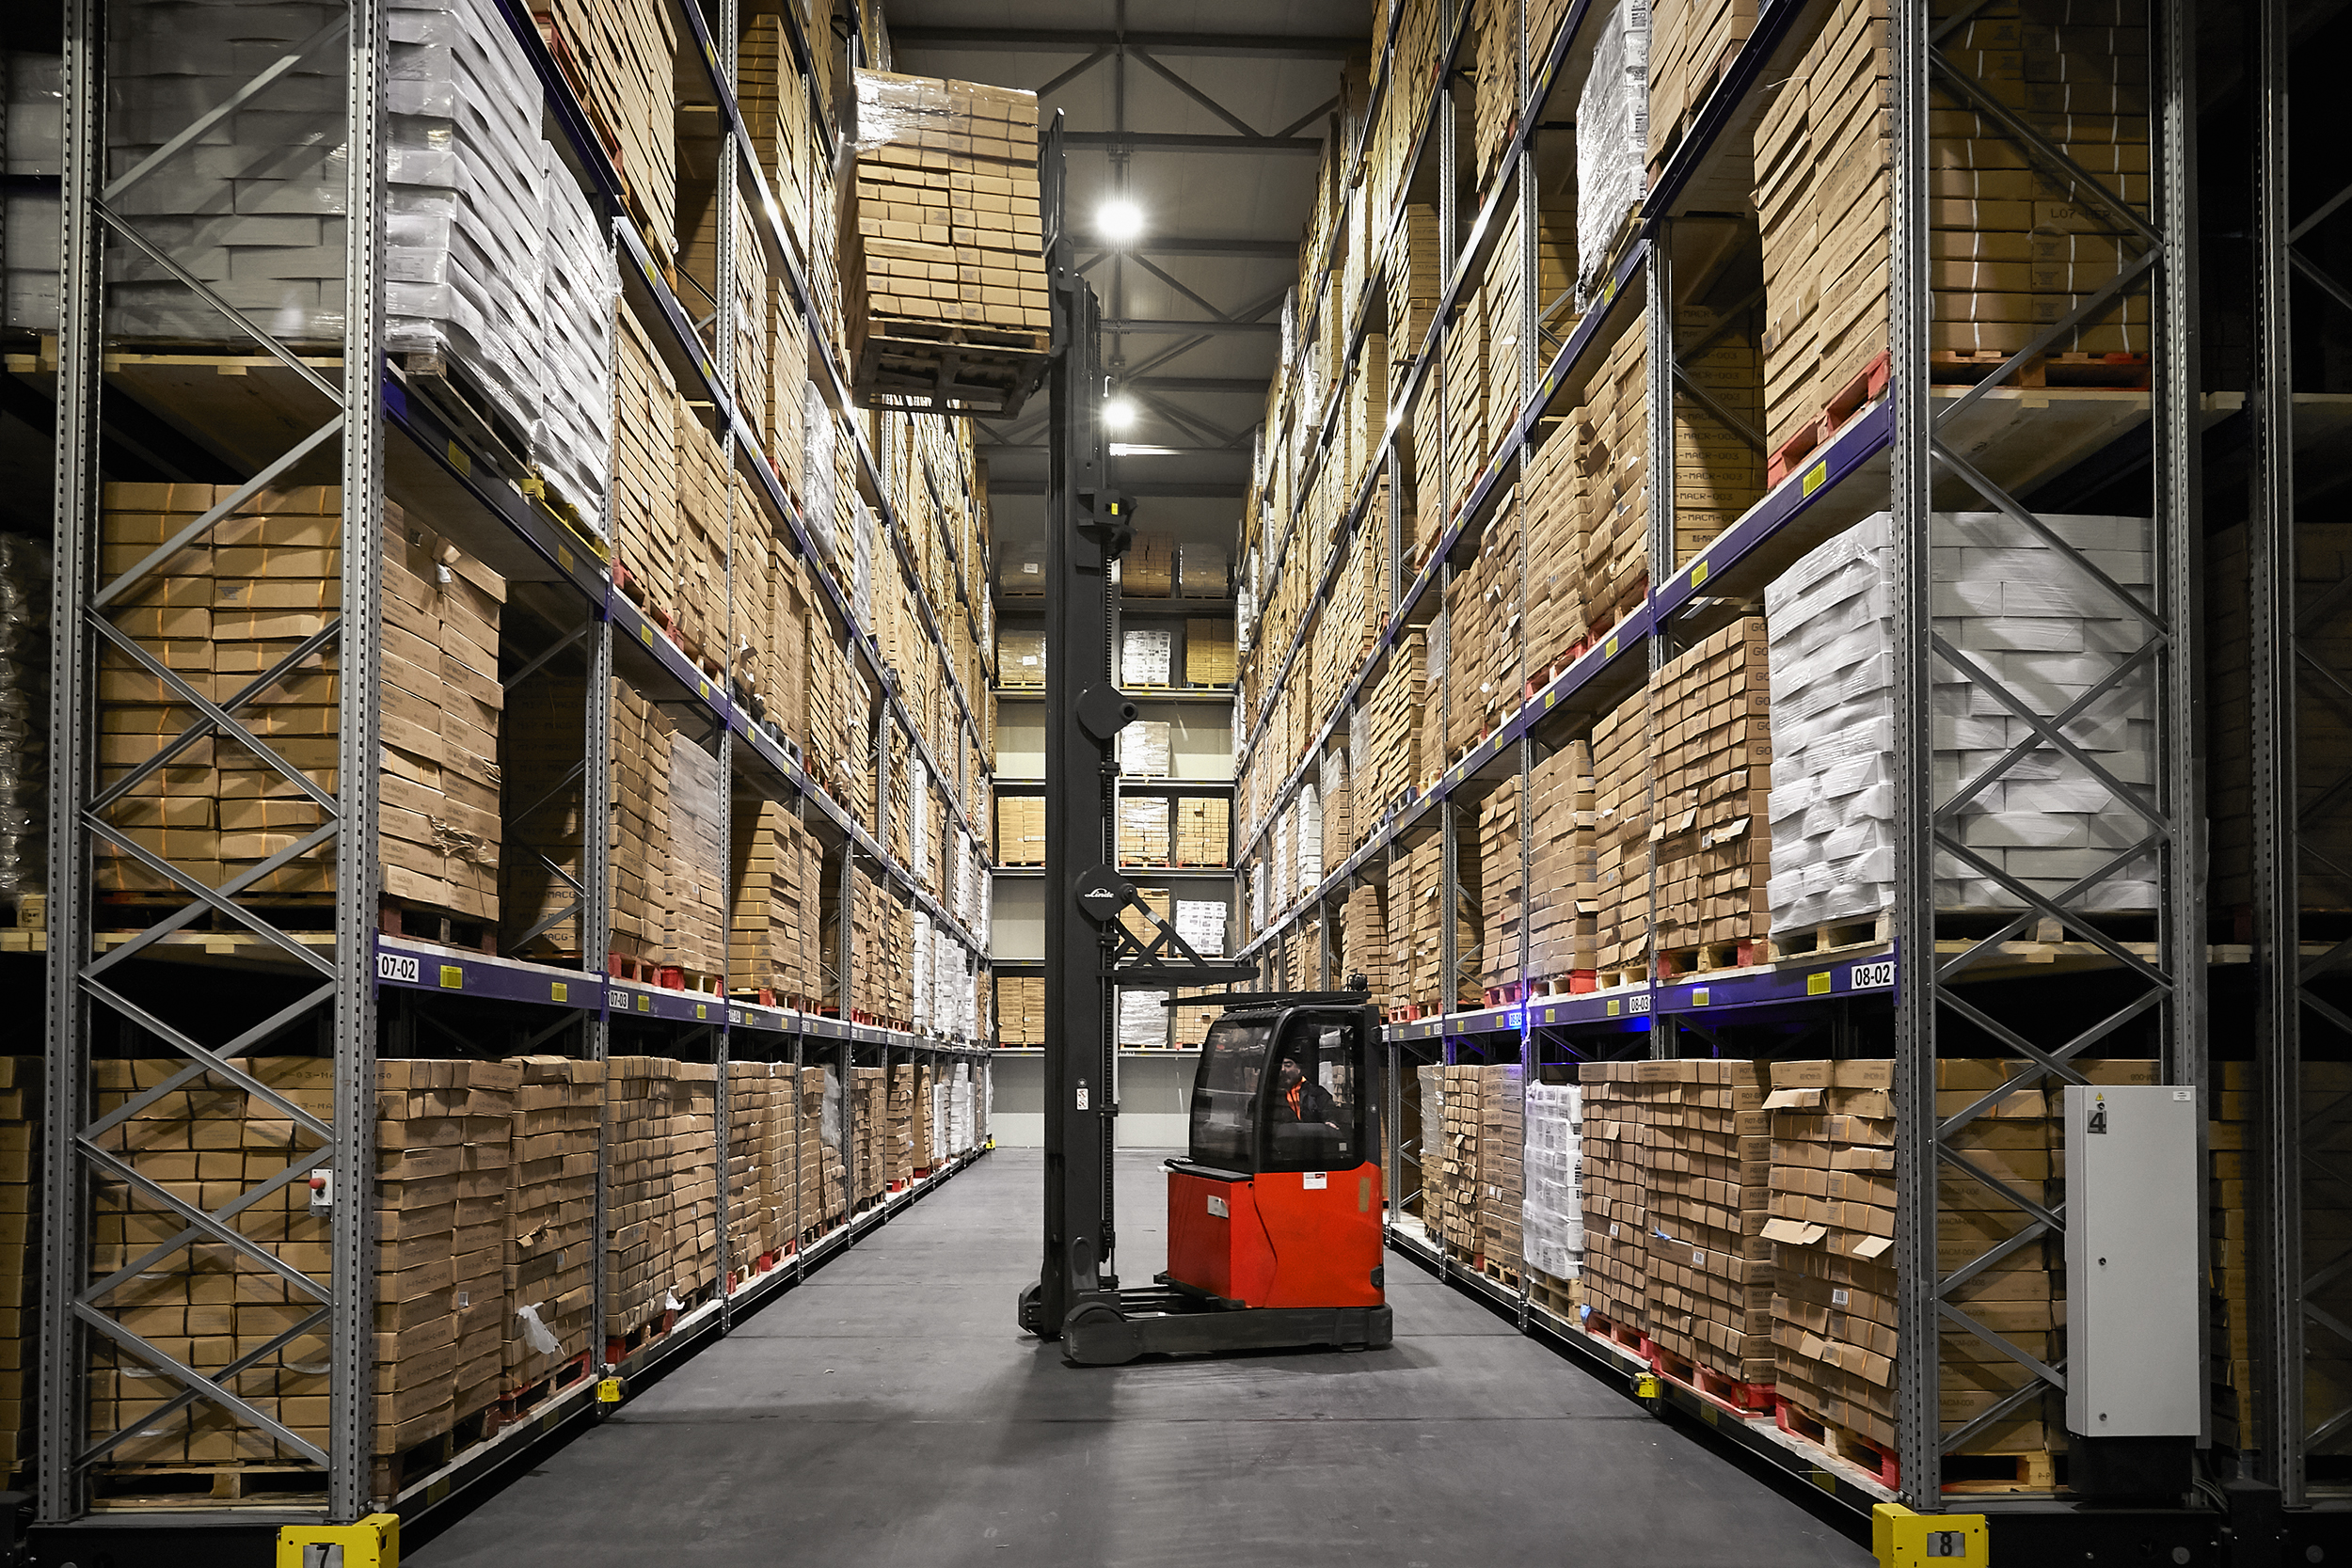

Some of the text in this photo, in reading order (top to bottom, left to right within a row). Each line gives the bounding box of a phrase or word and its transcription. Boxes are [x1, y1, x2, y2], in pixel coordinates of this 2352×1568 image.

[1084, 888, 1115, 899] Linde
[382, 956, 416, 979] 07-02
[1855, 964, 1891, 987] 08-02
[611, 991, 628, 1008] 07-03
[1631, 997, 1649, 1012] 08-03
[2090, 1112, 2106, 1132] 4
[1940, 1532, 1952, 1557] 8
[316, 1544, 329, 1568] 7
